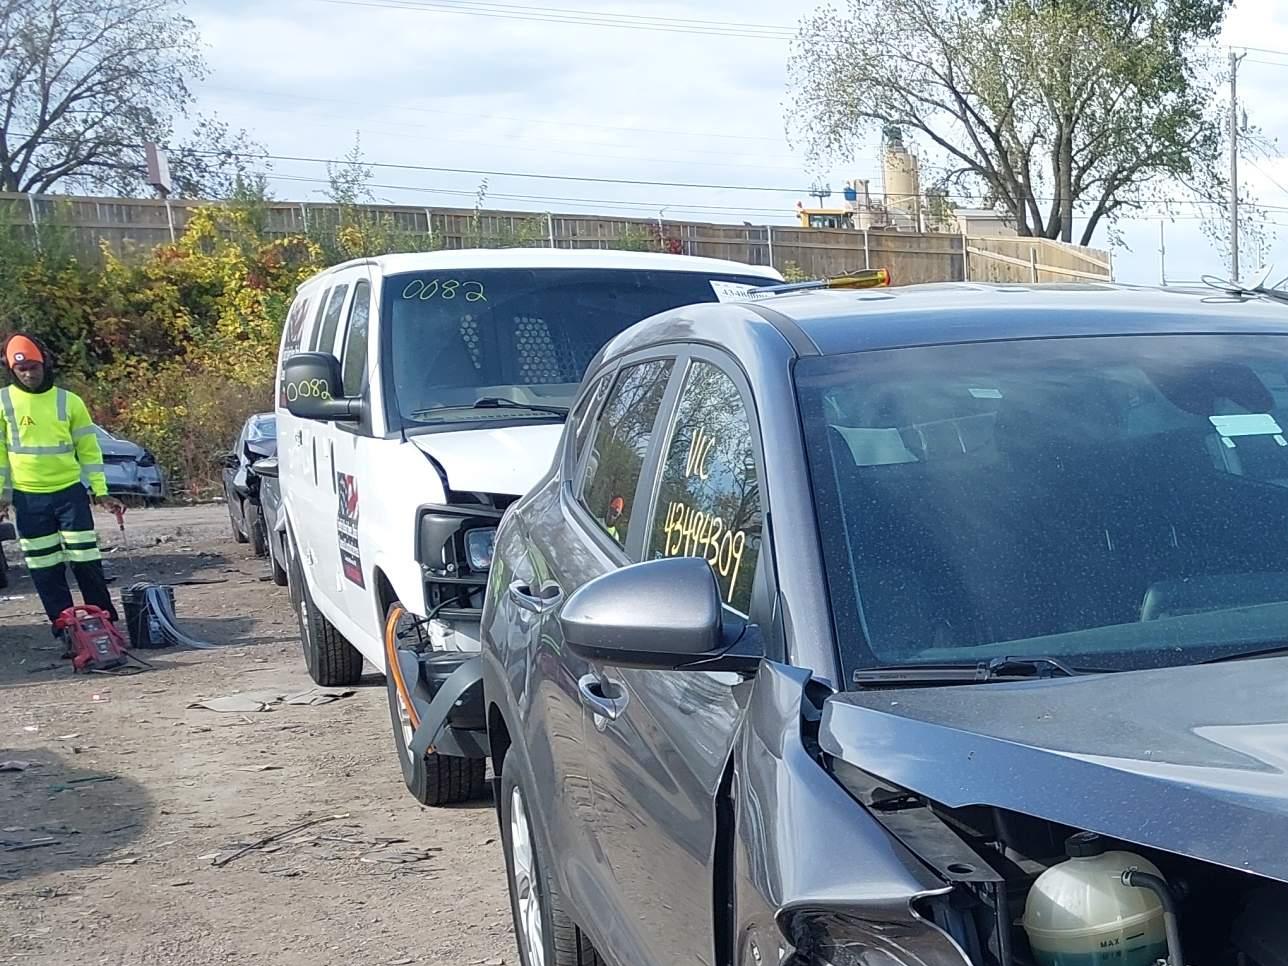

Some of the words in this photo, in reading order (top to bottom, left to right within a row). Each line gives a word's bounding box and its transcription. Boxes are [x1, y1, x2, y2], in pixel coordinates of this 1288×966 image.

[403, 279, 488, 302] 0082
[287, 378, 335, 402] 0082
[664, 501, 745, 603] 43494309
[1100, 938, 1119, 948] MAX
